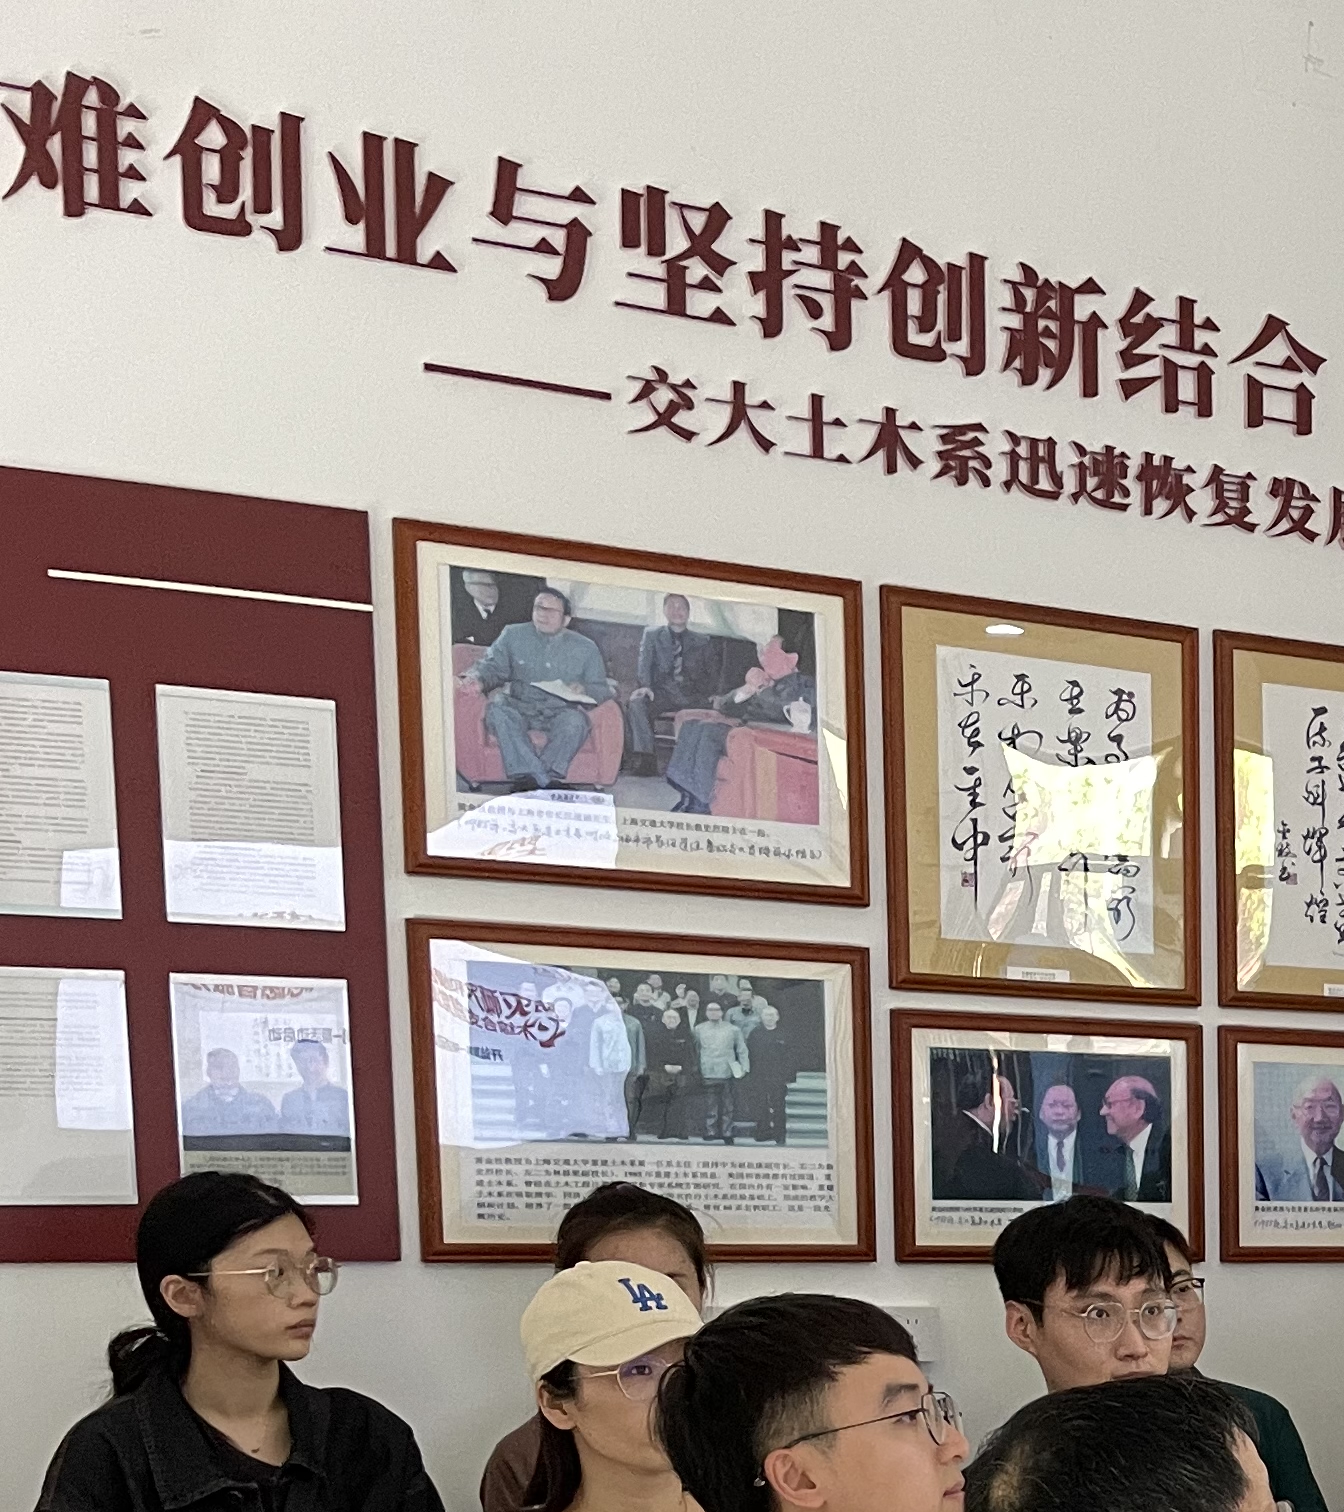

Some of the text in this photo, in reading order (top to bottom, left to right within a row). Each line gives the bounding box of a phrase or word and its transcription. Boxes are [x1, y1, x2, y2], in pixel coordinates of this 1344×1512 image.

[0, 71, 1327, 436] 难创业与坚持创新结合
[618, 1278, 668, 1311] LA
